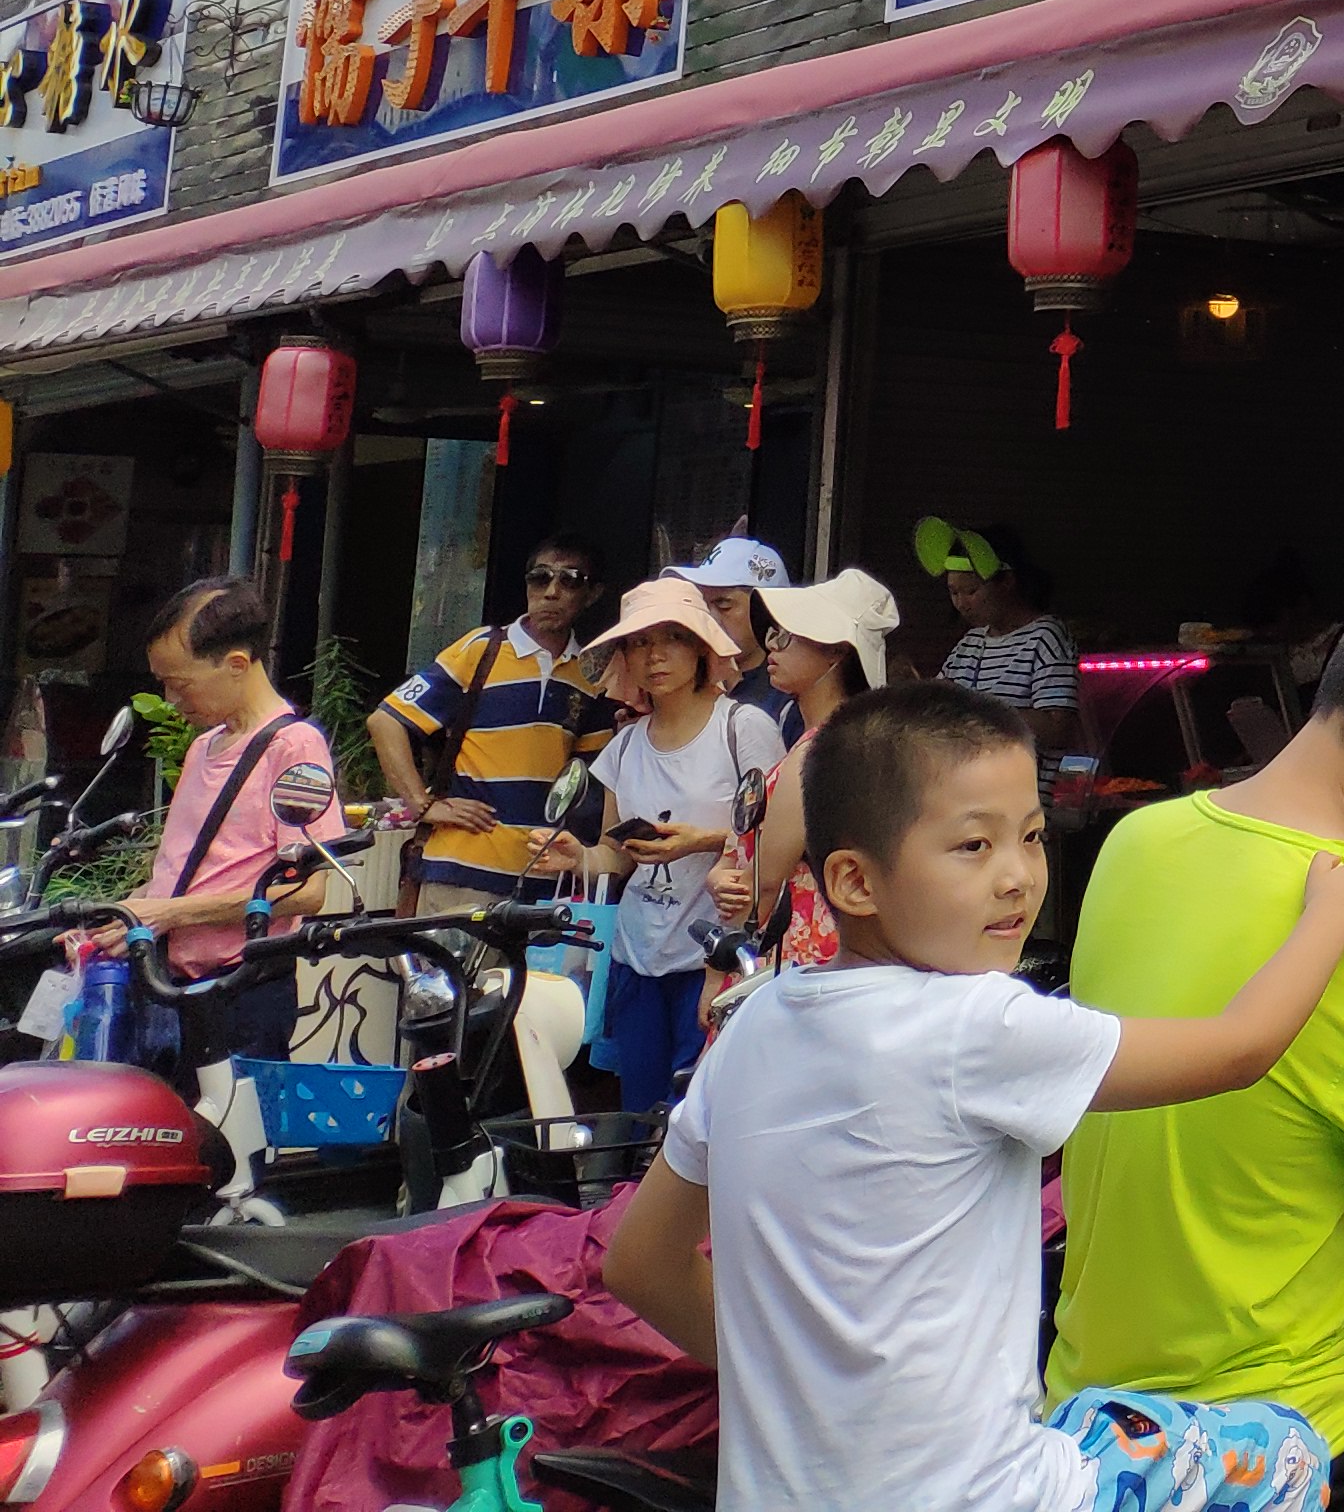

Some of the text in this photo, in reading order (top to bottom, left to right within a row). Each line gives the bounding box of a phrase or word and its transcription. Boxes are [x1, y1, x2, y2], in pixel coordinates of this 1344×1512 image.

[755, 68, 1095, 184] 细节彰显文明
[68, 1127, 156, 1143] LEIZHI
